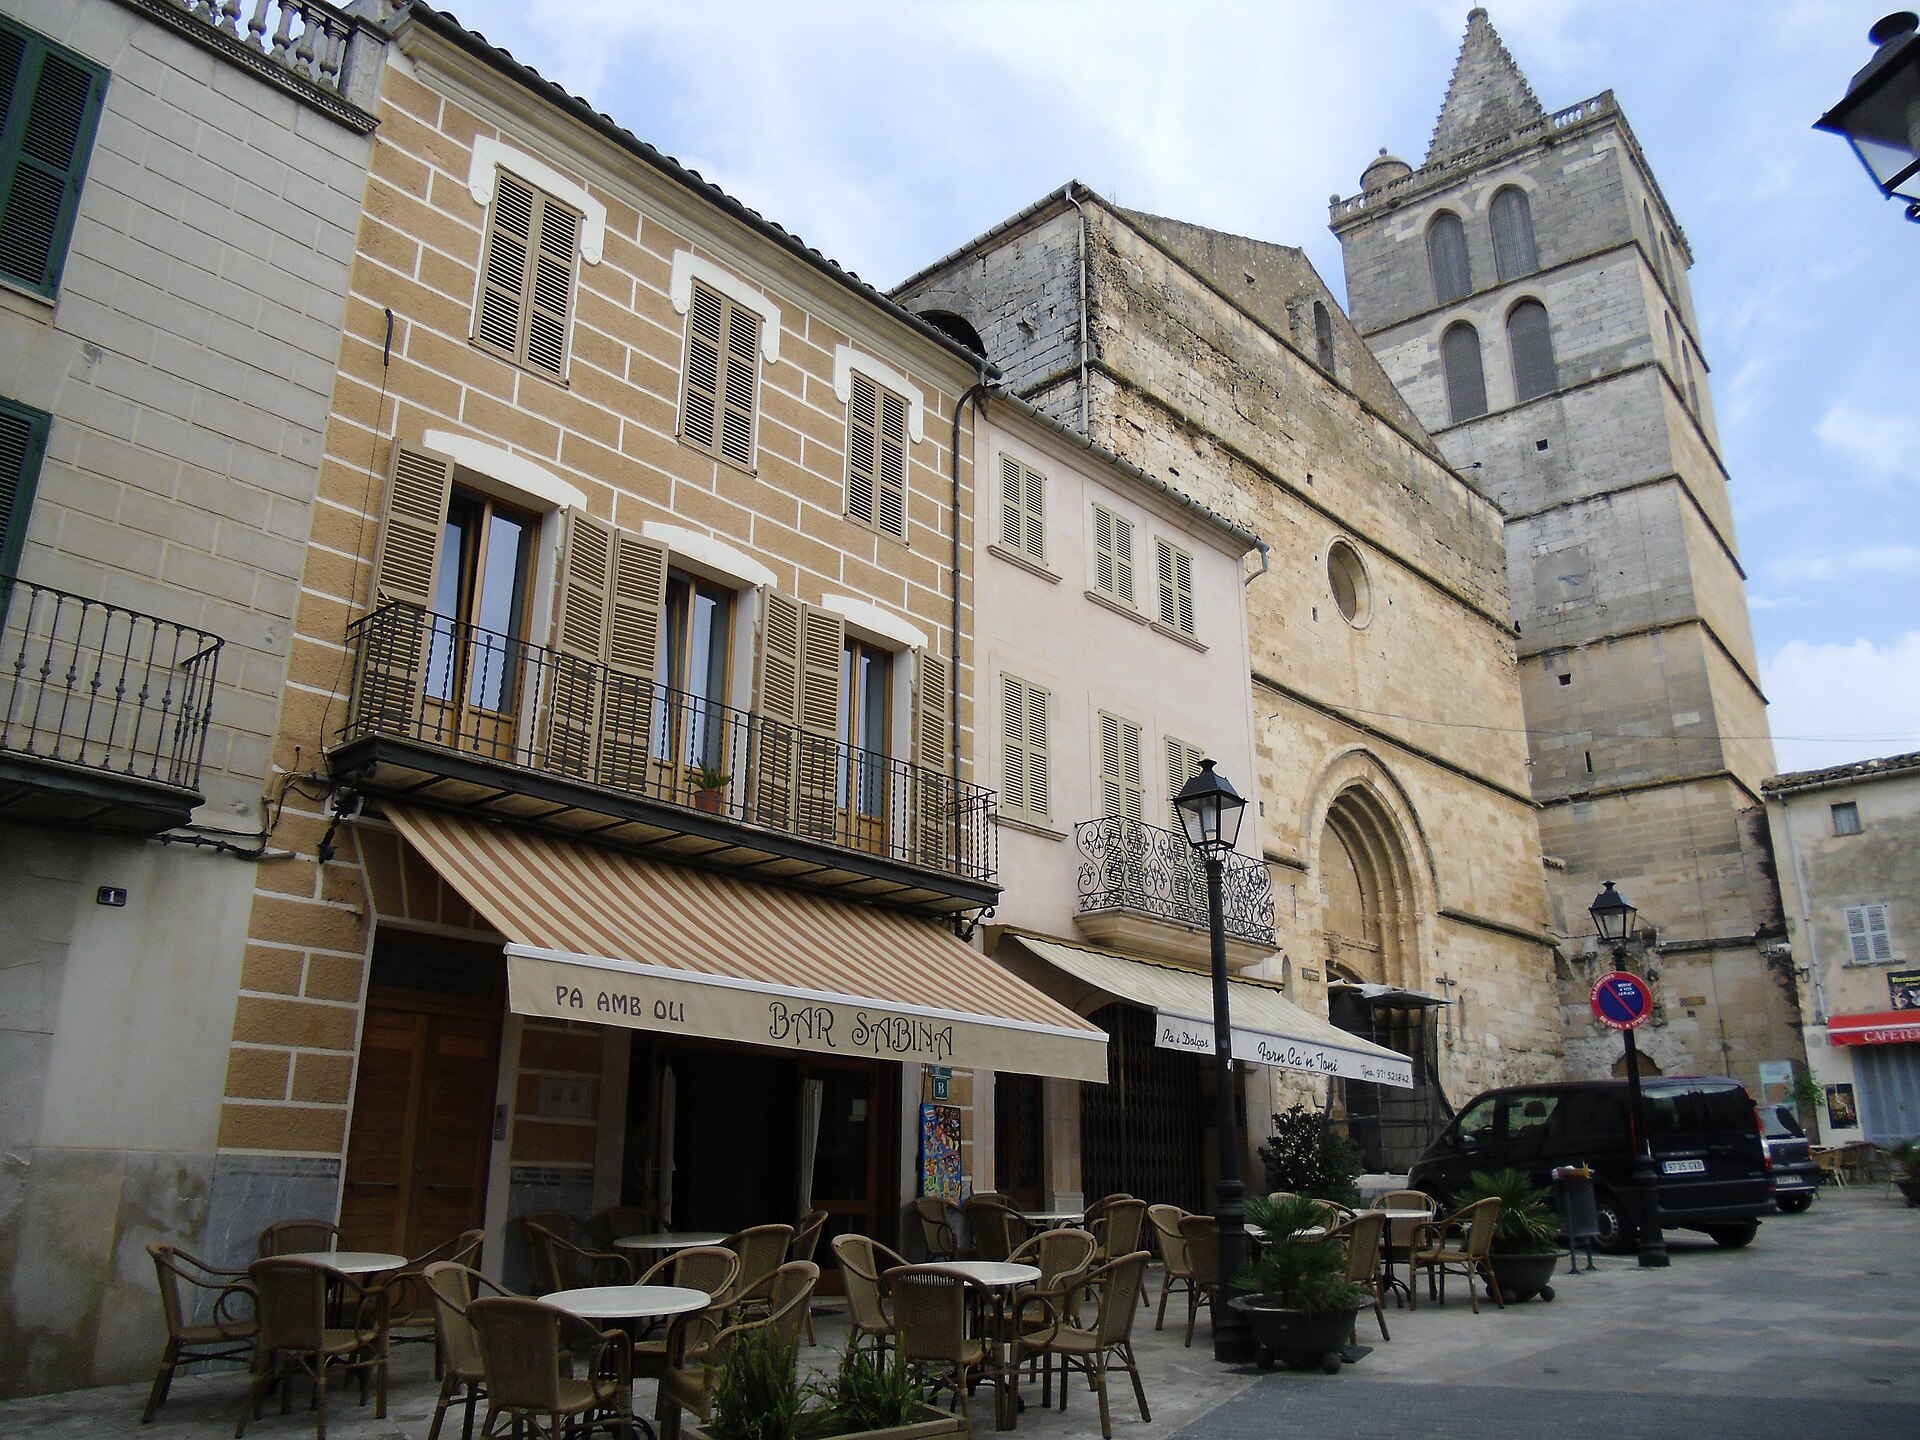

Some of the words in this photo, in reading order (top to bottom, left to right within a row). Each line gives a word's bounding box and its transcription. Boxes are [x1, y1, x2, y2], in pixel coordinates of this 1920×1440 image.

[109, 890, 115, 903] 1
[555, 985, 584, 1009] PA
[596, 991, 642, 1016] AMB
[653, 999, 685, 1022] OLI
[768, 1001, 837, 1048] BAR
[851, 1011, 952, 1061] SABINA
[1161, 1028, 1175, 1043] Pa
[1176, 1033, 1180, 1044] i
[1257, 1041, 1286, 1064] Forn
[1287, 1046, 1315, 1068] Ca'n
[1315, 1052, 1338, 1072] Toni
[937, 1082, 945, 1094] B
